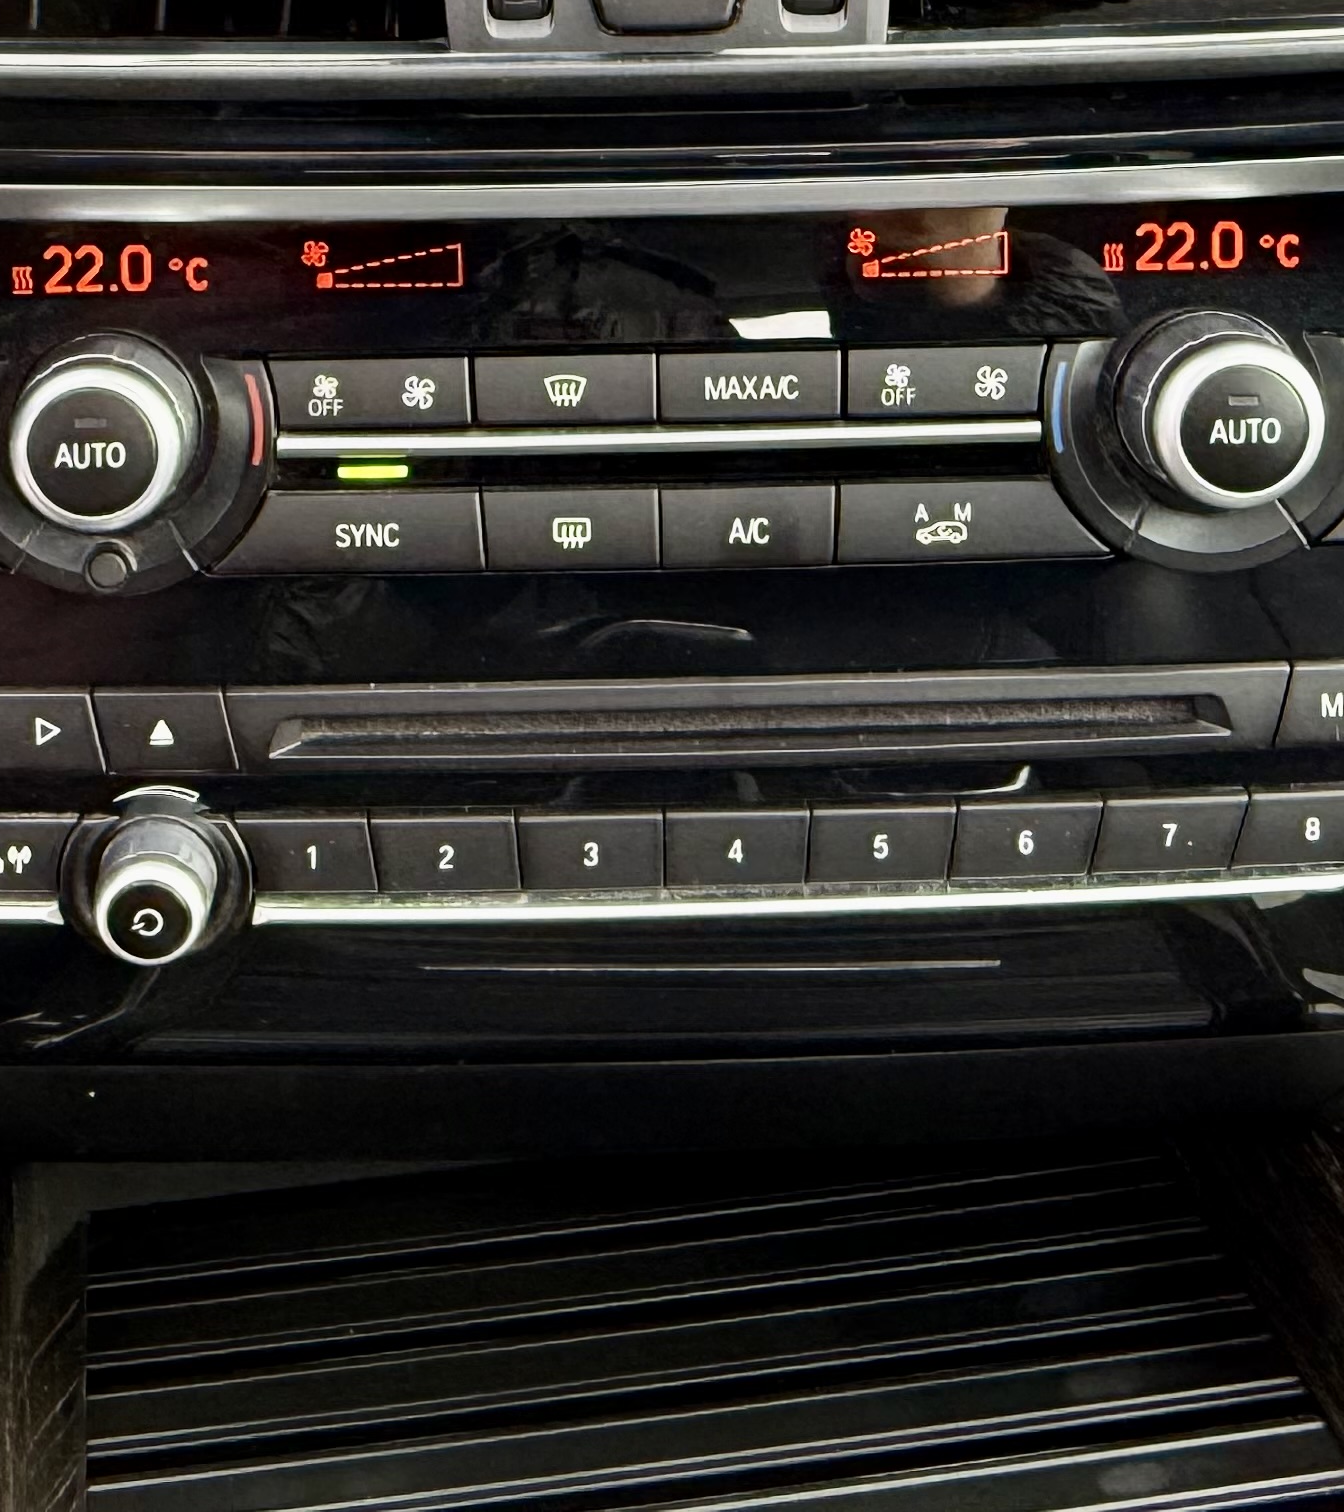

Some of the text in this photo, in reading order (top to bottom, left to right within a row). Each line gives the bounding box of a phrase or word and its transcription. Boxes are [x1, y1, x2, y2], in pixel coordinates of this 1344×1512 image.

[1134, 221, 1244, 271] 22.0
[43, 244, 152, 293] 22.0
[704, 375, 799, 400] MAX A/C
[881, 387, 916, 406] OFF
[308, 398, 344, 416] OFF
[1209, 418, 1282, 445] AUTO
[54, 441, 126, 469] AUTO
[914, 503, 972, 524] A M
[335, 523, 400, 548] SYNC
[728, 518, 770, 545] A/C
[306, 817, 1321, 870] 1 2 3 4 5 6 7 8
